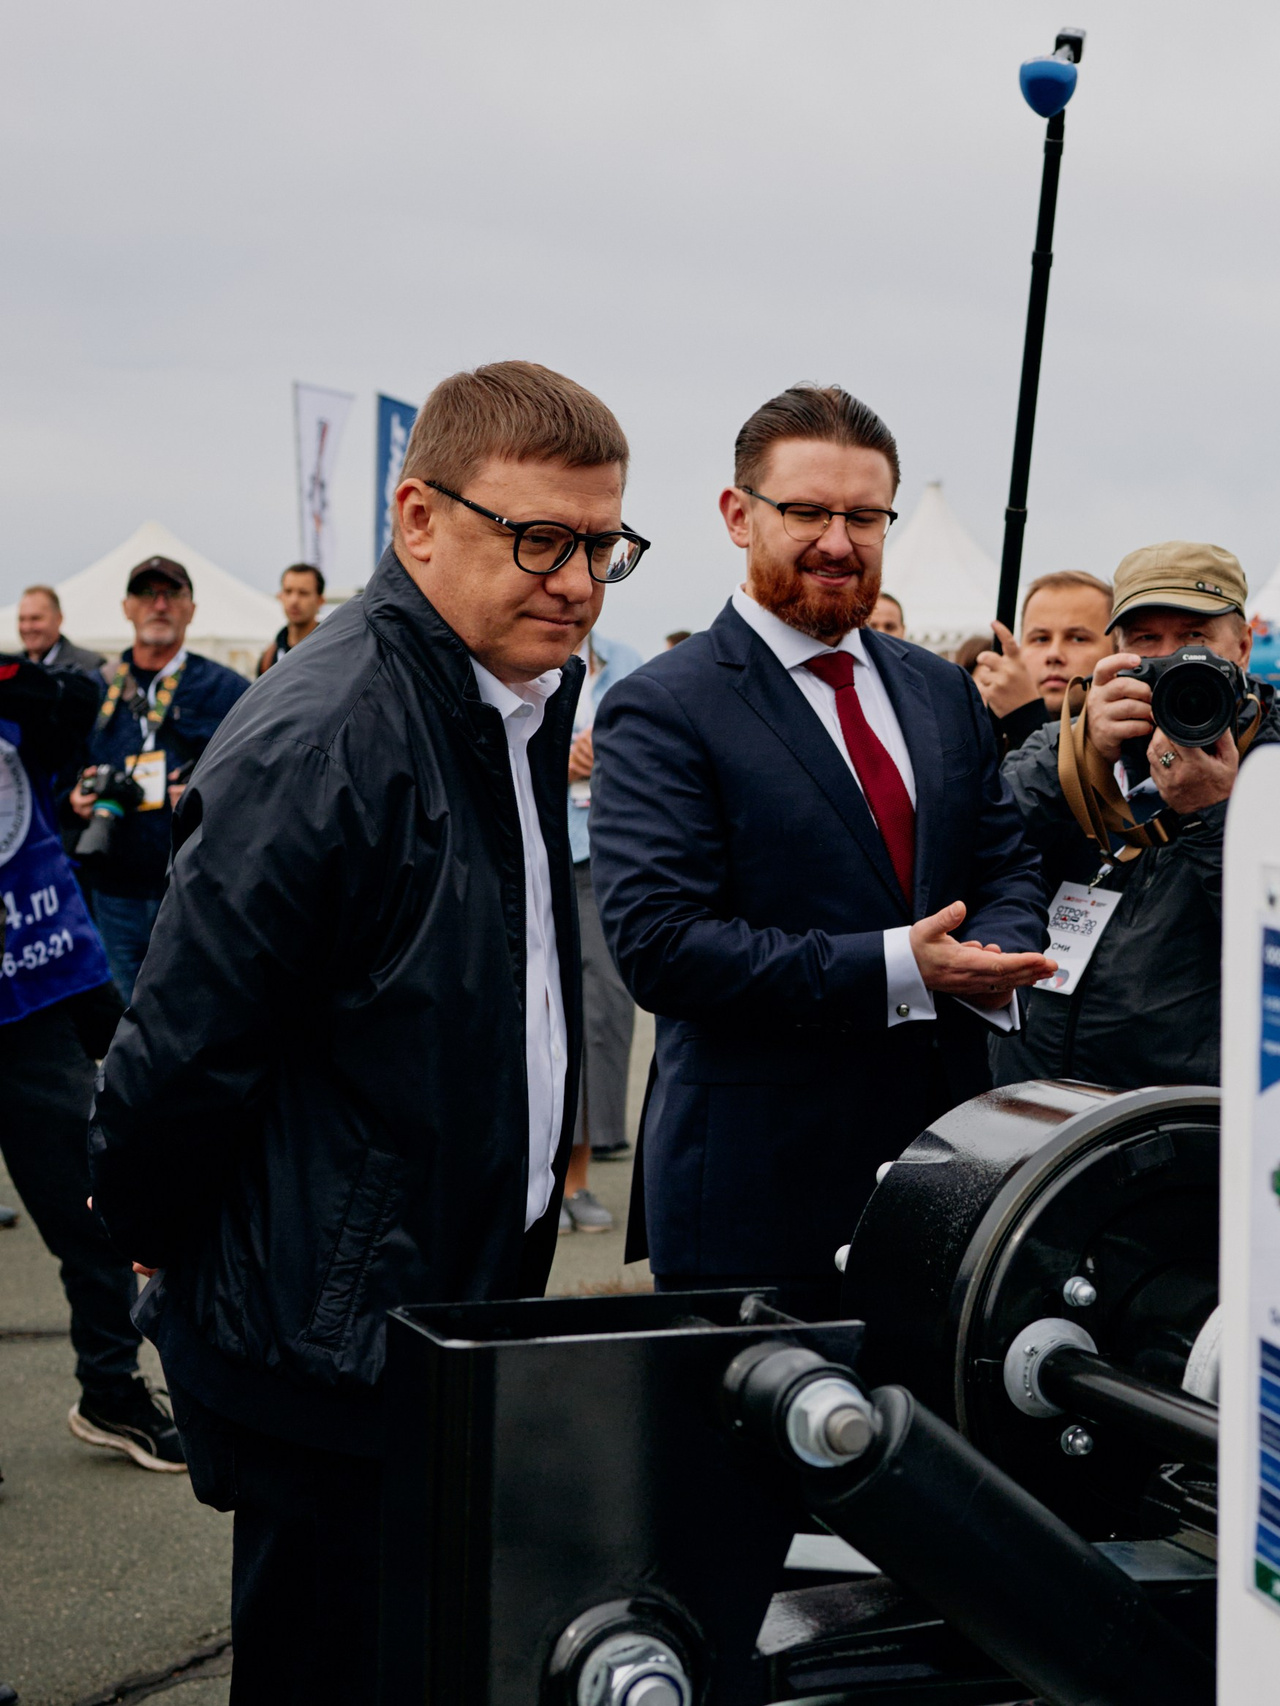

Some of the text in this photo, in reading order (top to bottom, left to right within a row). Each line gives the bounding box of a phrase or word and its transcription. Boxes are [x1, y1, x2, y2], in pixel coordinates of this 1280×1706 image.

[1182, 653, 1207, 661] Canon
[1051, 942, 1071, 953] СМИ
[0, 928, 74, 979] 6-52-21
